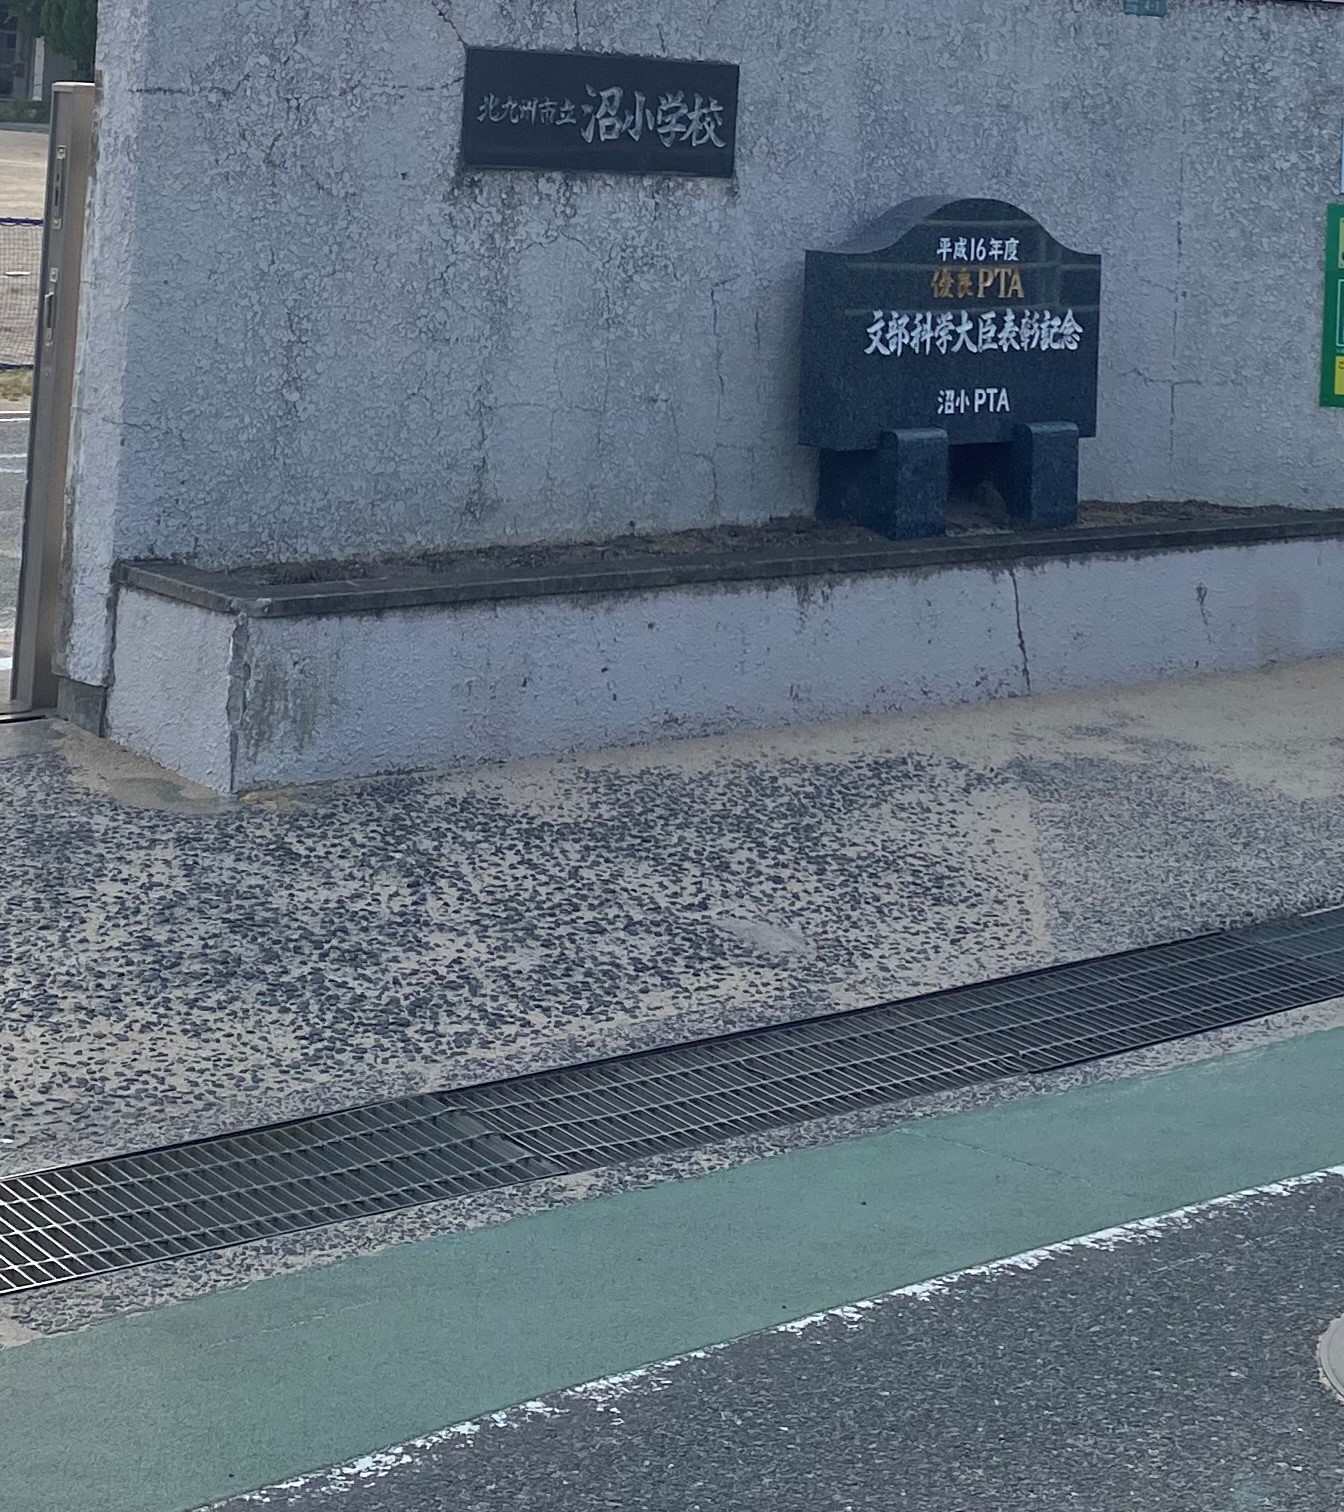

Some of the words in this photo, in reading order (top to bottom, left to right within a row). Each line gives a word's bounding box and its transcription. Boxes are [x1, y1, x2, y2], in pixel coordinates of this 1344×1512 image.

[936, 237, 1020, 262] 平成16年度
[864, 308, 1084, 357] 文部科学大臣表彰記念
